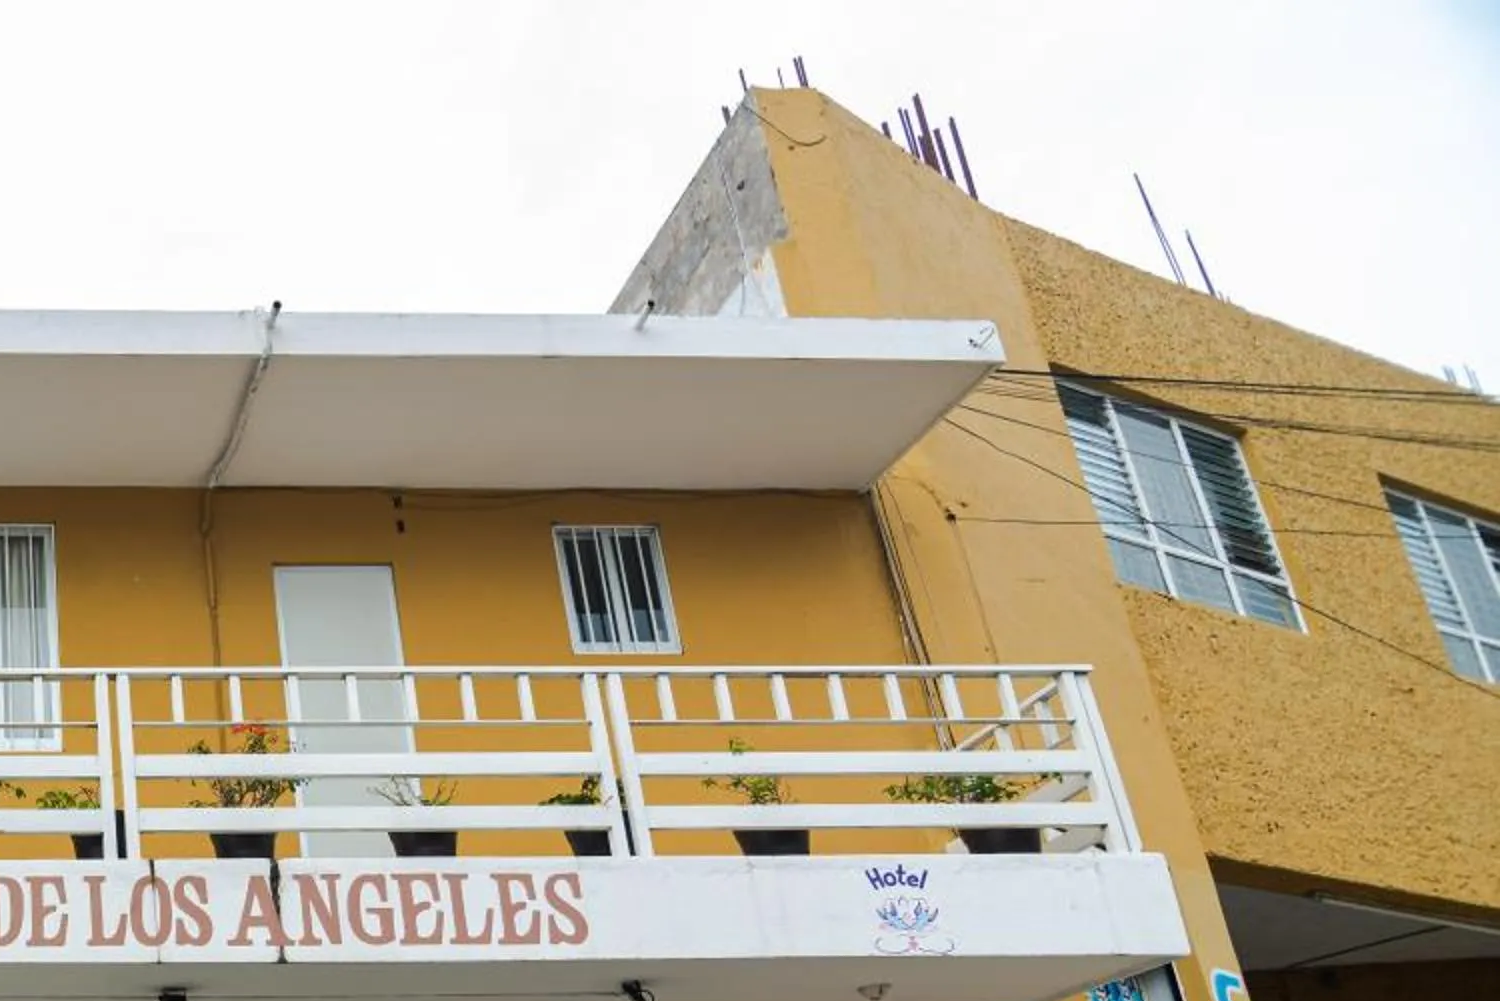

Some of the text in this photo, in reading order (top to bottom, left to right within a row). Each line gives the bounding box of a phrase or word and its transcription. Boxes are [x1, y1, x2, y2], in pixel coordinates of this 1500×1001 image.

[864, 863, 928, 891] Hotel
[84, 874, 213, 948] LOS
[227, 872, 590, 948] ANGELES
